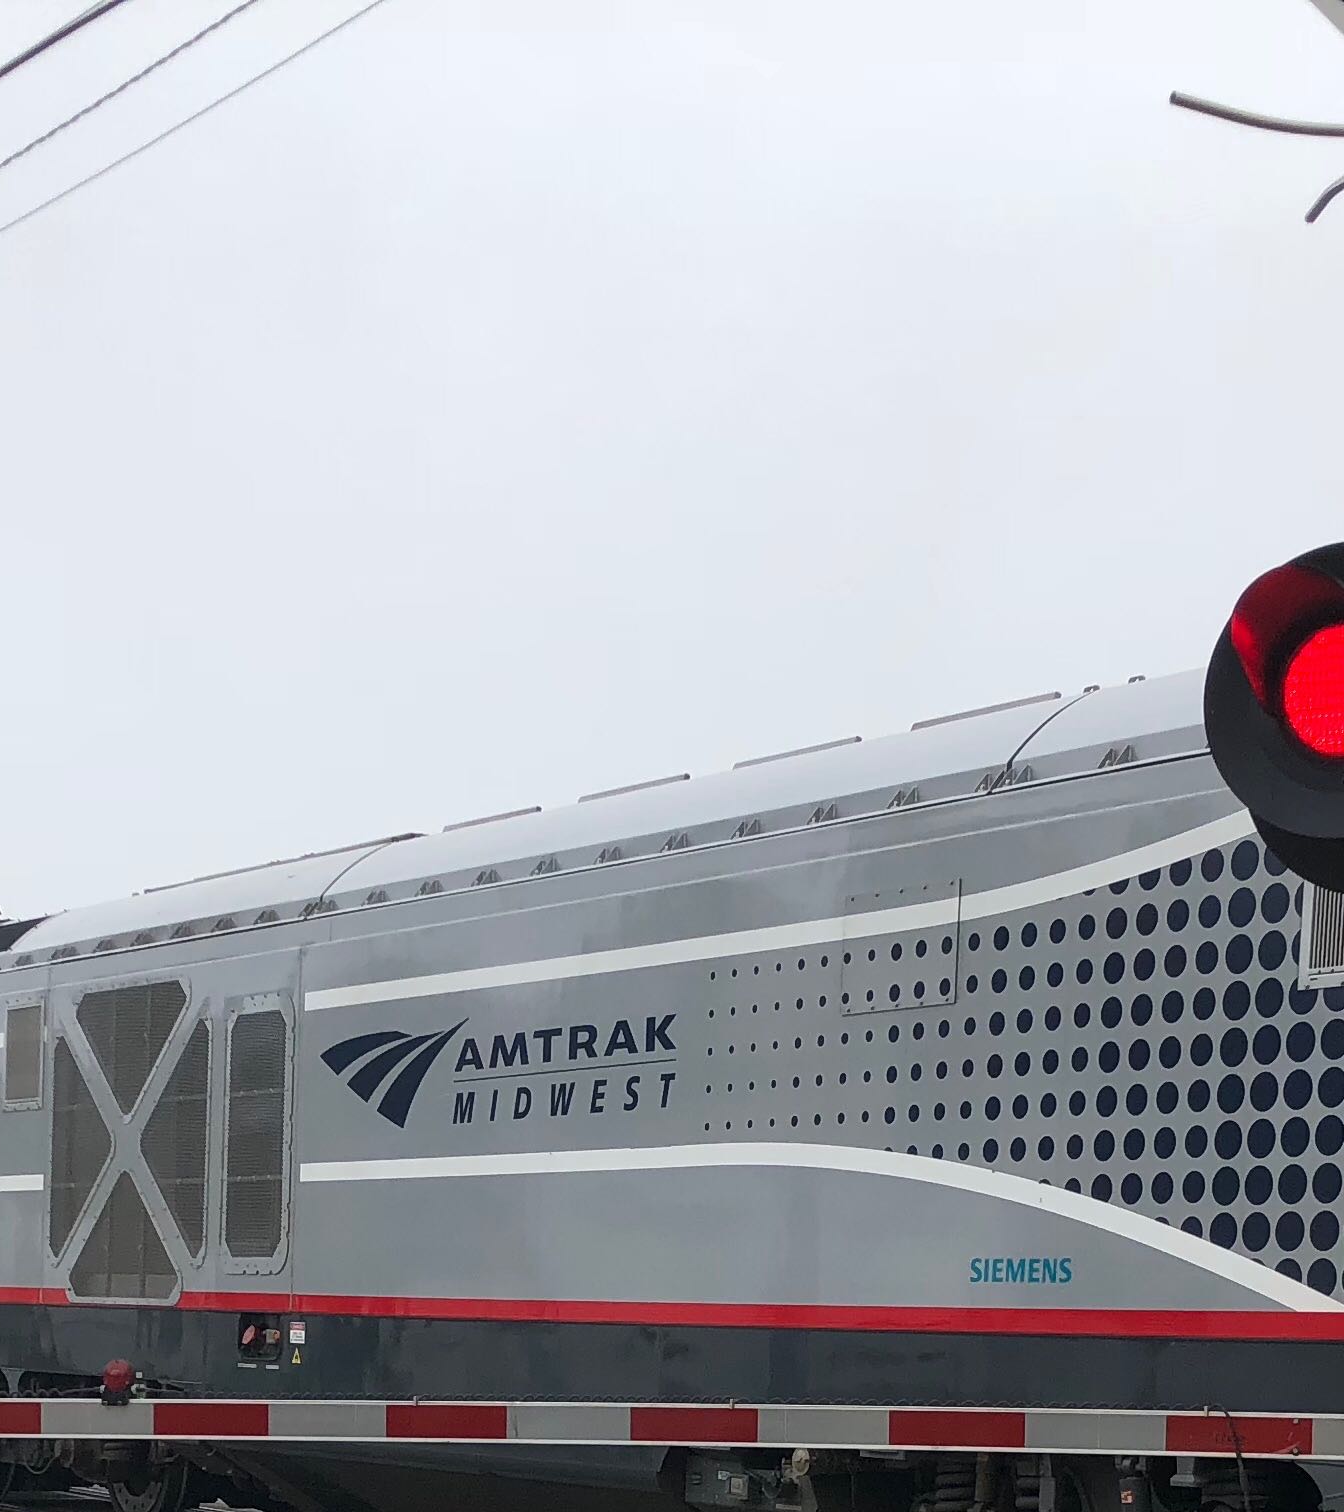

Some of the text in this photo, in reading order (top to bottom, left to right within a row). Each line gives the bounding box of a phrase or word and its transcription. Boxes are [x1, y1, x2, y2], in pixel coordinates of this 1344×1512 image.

[454, 1013, 677, 1072] AMTRAK
[452, 1072, 677, 1125] MIDWEST
[970, 1257, 1072, 1283] SIEMENS
